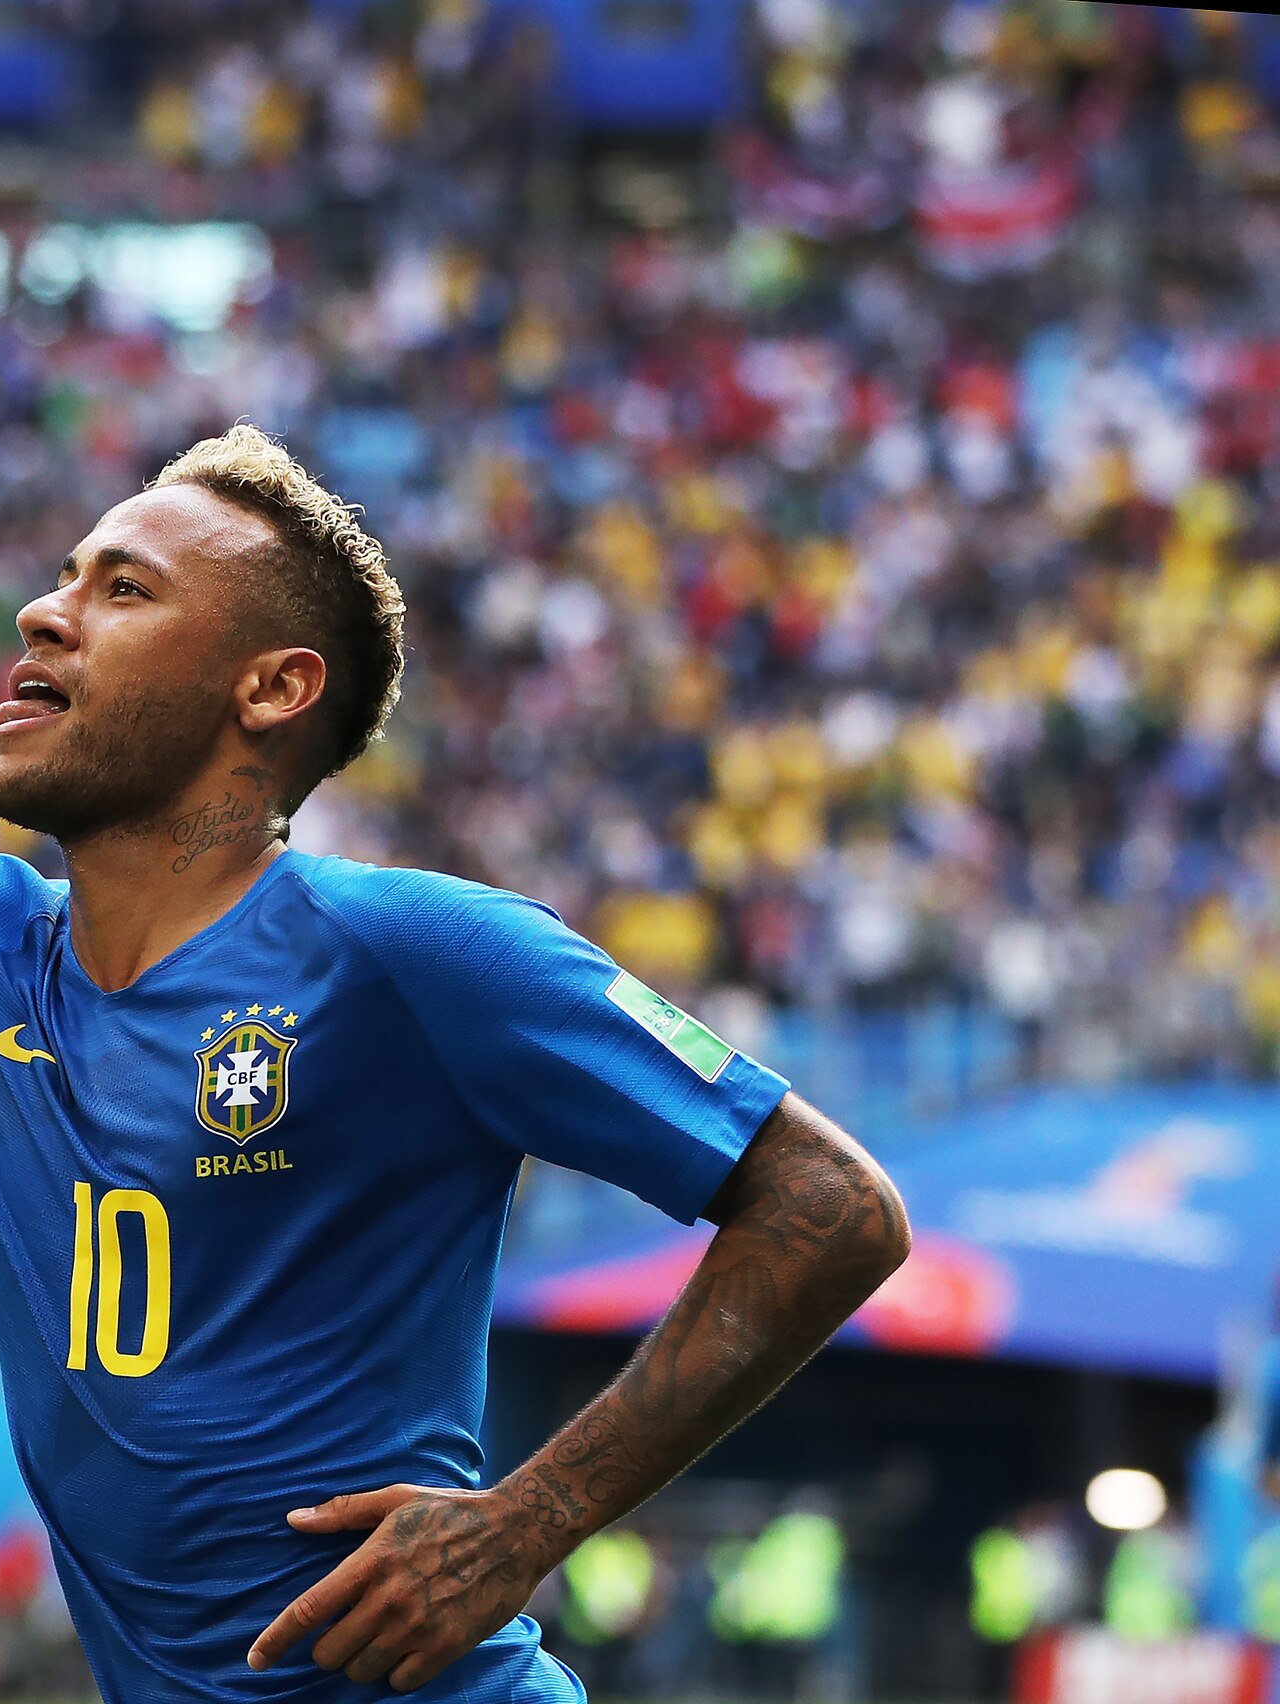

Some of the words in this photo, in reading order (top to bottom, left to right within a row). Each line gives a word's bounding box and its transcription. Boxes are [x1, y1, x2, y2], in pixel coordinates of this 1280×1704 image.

[168, 791, 254, 845] Tudo
[226, 1070, 259, 1086] CBF
[195, 1150, 293, 1178] BRASIL
[66, 1180, 171, 1378] 10
